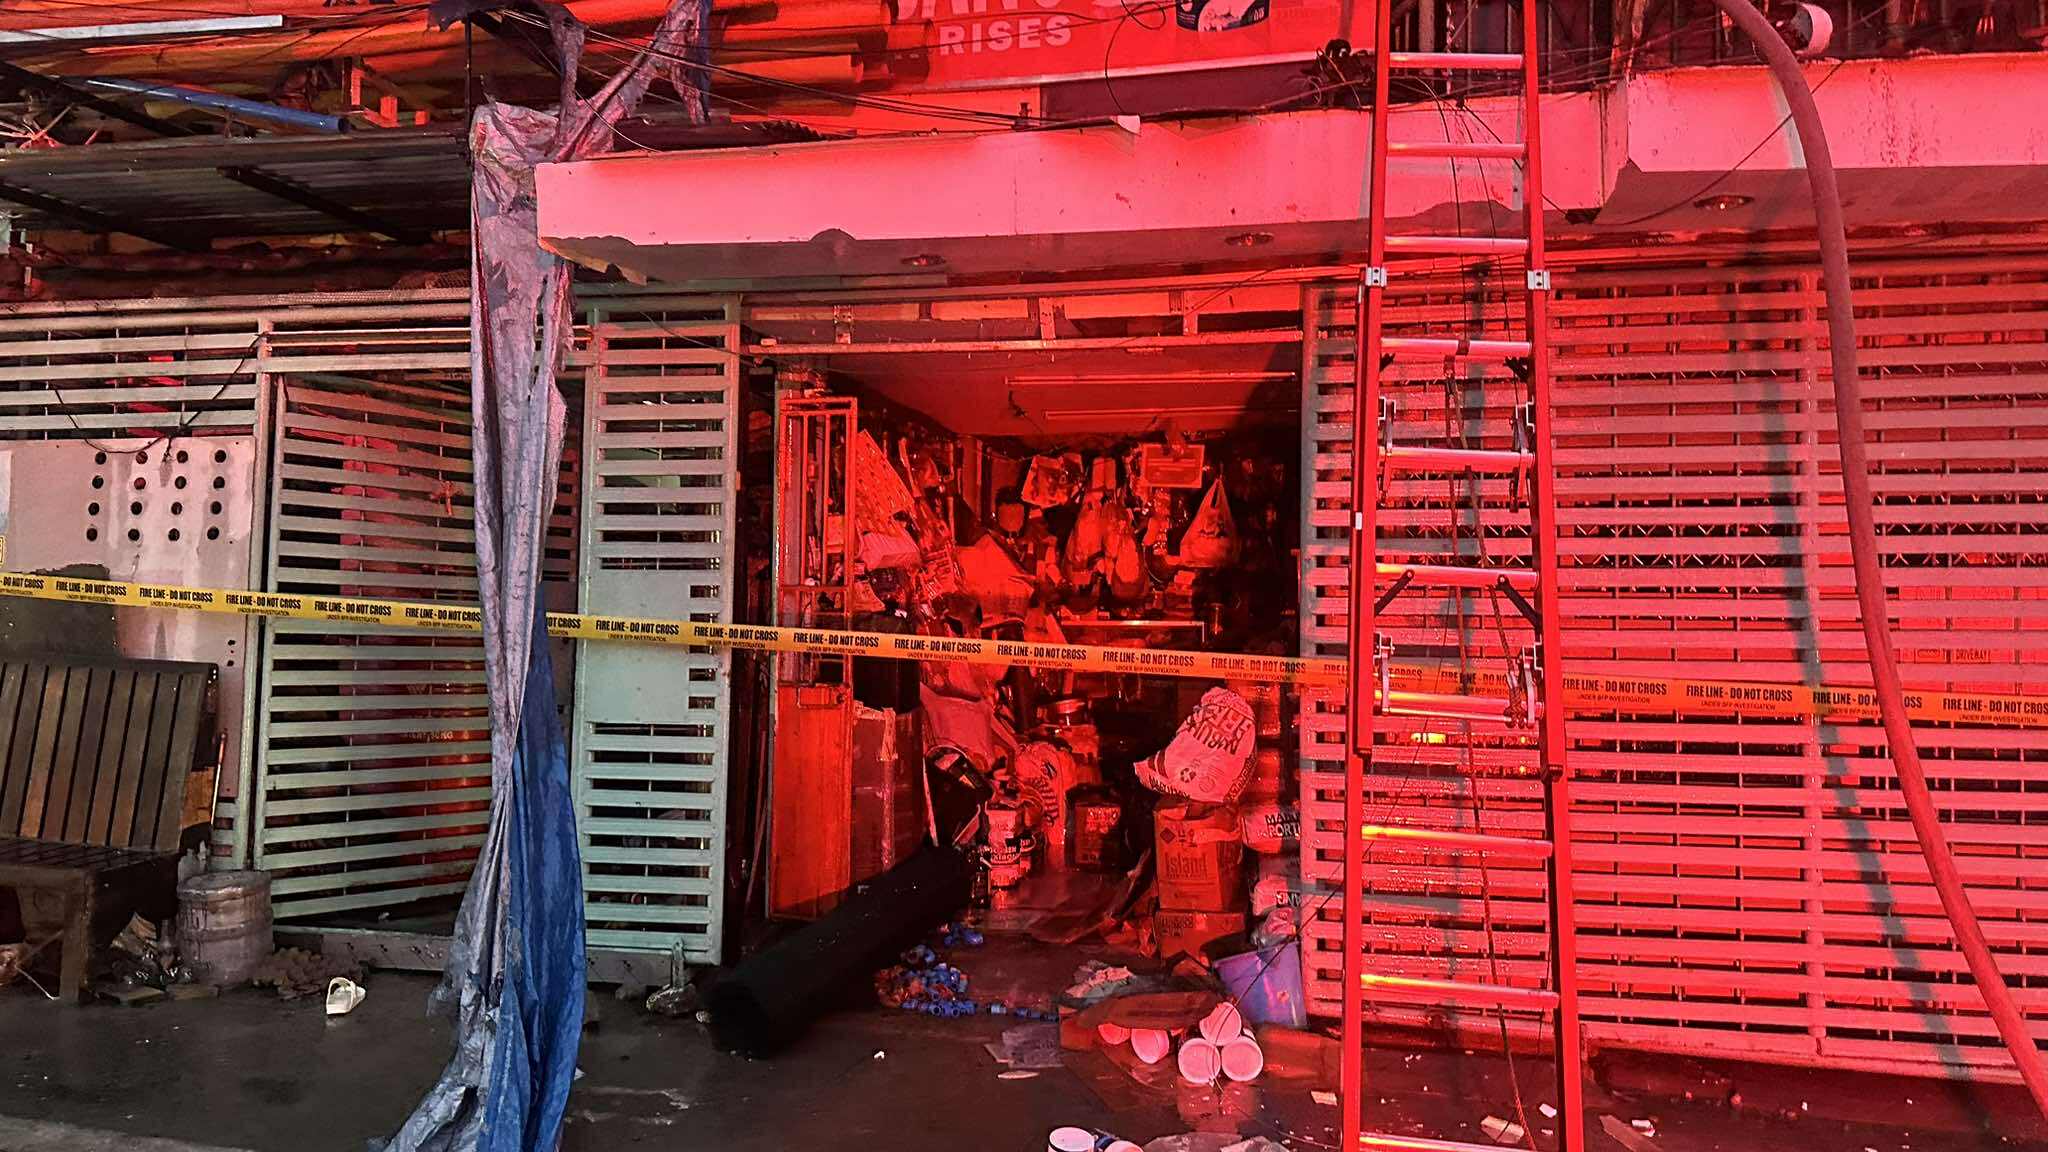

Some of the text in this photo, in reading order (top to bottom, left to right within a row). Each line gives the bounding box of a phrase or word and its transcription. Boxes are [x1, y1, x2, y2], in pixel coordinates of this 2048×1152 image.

[939, 14, 1072, 56] RISES
[3, 576, 44, 589] DO NOT CROSS
[57, 581, 127, 596] FIRE LINE DO NOT CROSS
[139, 588, 213, 602] FIRE LINE DO NOT CROSS
[226, 594, 301, 609] FIRE LINE DO NOT CROSS
[315, 601, 391, 616] FIRE LINE DO NOT CROSS
[405, 607, 481, 622] FIRE LINE DO NOT CROS
[558, 618, 581, 629] CROSS
[596, 620, 679, 635] FIRE LINE DO NOT CROSS
[694, 626, 779, 641] FIRE LINE DO NOT CROSS
[793, 632, 879, 647] FIRE LINE DO NOT CROSS
[895, 639, 982, 653] FIRE LINE DO NOT CROSS
[997, 645, 1086, 660] FIRE LINE DO NOT CROSS
[1103, 651, 1194, 667] FIRE LINE DO NOT CROSS
[1211, 657, 1306, 673] FIRE LINE DO NOT CROSS
[1496, 674, 1508, 685] NO
[1563, 678, 1667, 695] FIRE LINE DO NOT CROSS
[1687, 686, 1792, 701] FIRE LINE DO NOT CROSS
[1813, 691, 1831, 703] FIRE
[1832, 692, 1851, 704] LINE
[1857, 694, 1870, 705] DO
[1904, 696, 1922, 708] OSS
[1943, 698, 2048, 715] FIRE LINE DO NOT CROS
[1165, 852, 1207, 875] Island
